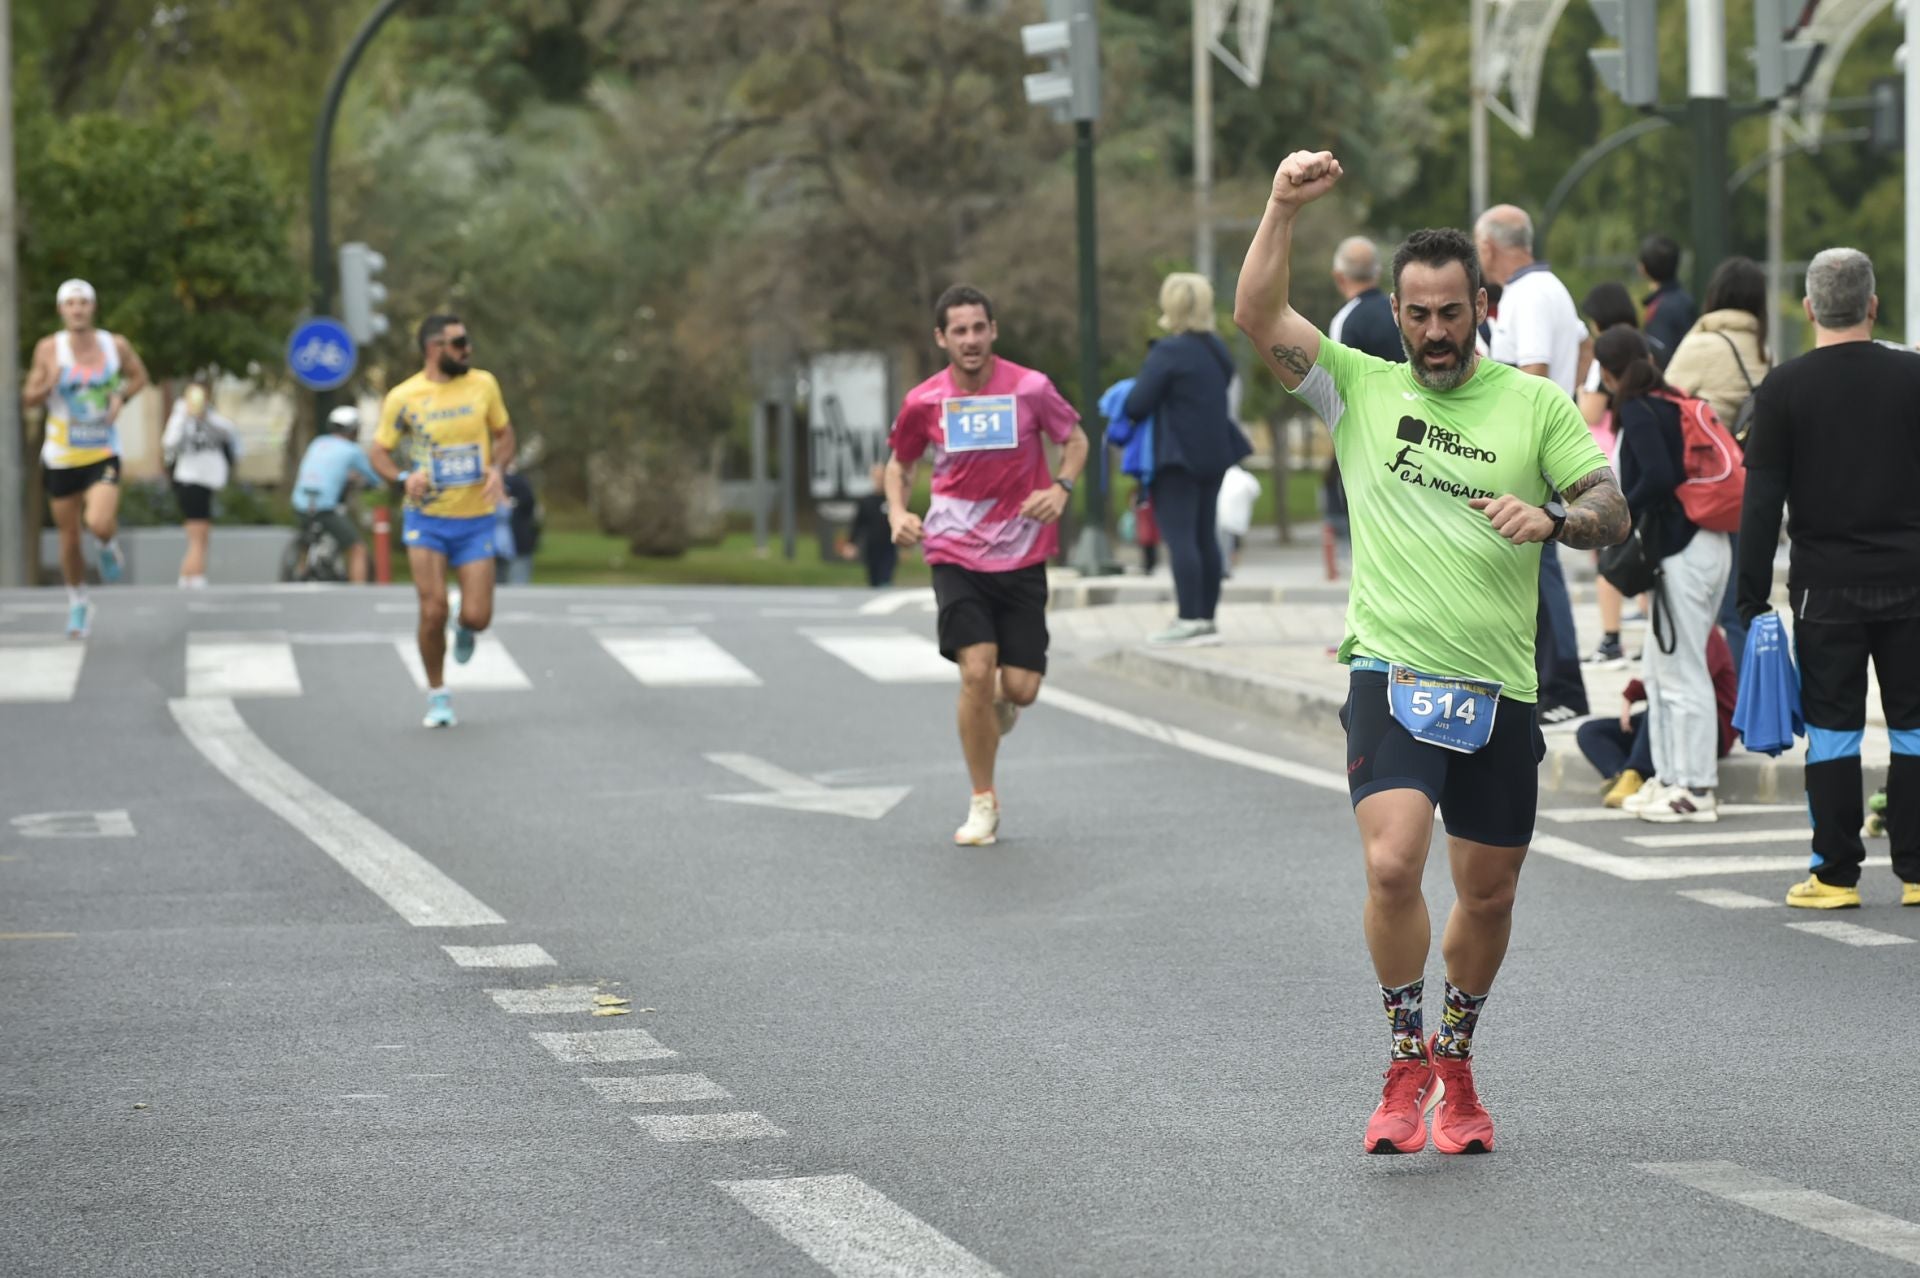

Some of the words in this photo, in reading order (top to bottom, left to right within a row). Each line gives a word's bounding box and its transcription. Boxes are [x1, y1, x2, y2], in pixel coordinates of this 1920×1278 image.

[958, 412, 1001, 433] 151
[1427, 424, 1460, 444] pan
[1429, 438, 1497, 463] moreno
[1400, 470, 1426, 487] C.A.
[1411, 691, 1476, 725] 514
